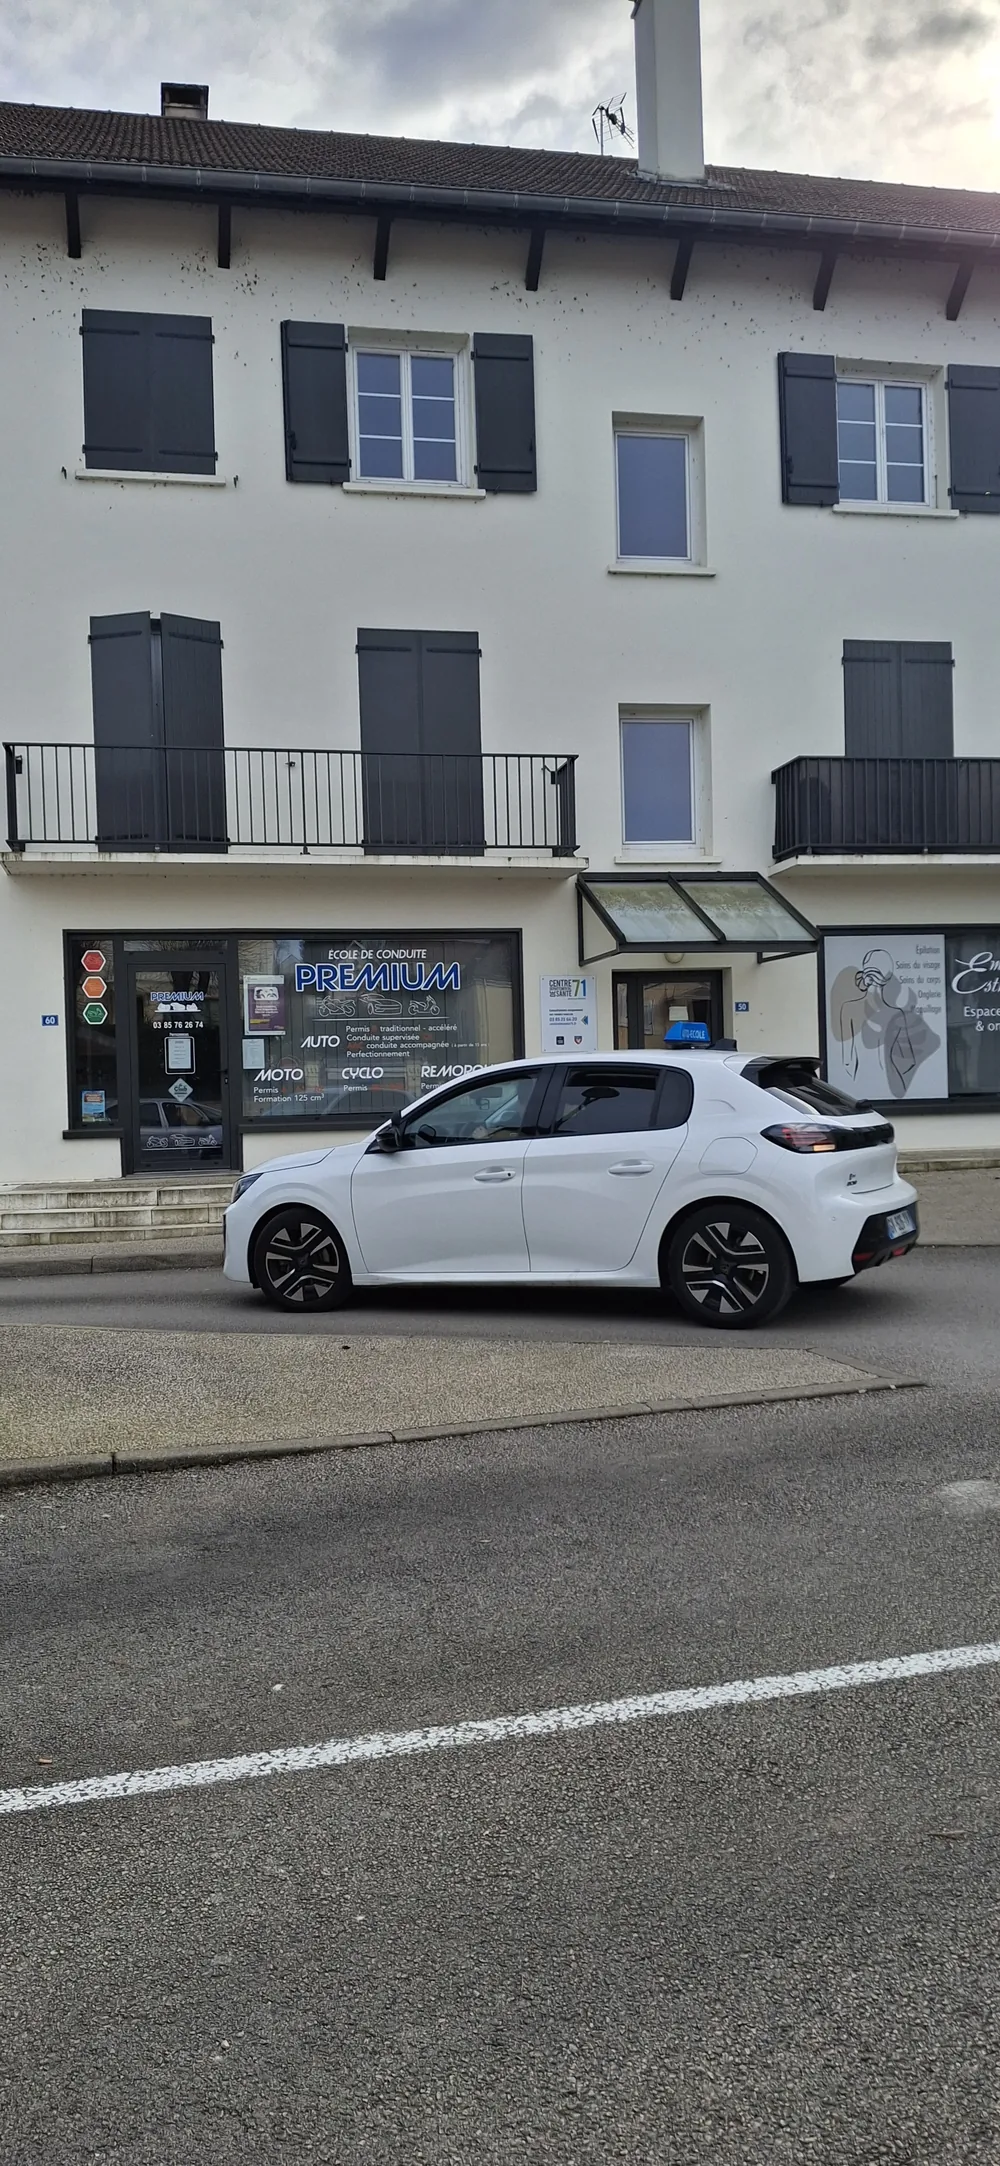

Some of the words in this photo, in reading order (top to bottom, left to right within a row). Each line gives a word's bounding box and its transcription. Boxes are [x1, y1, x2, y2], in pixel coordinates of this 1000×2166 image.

[361, 950, 373, 959] DE
[376, 949, 427, 959] CONDUITE
[295, 962, 460, 992] PREMIUM
[548, 980, 572, 988] CENTRE
[572, 978, 586, 997] 71
[150, 991, 204, 1001] PREMIUM
[975, 1021, 984, 1031] &
[301, 1035, 340, 1048] AUTO
[382, 1034, 420, 1042] supervisée
[400, 1041, 449, 1049] accompagnée
[254, 1068, 303, 1082] MOTO
[342, 1067, 384, 1079] CYCLO
[421, 1064, 494, 1077] REMOR
